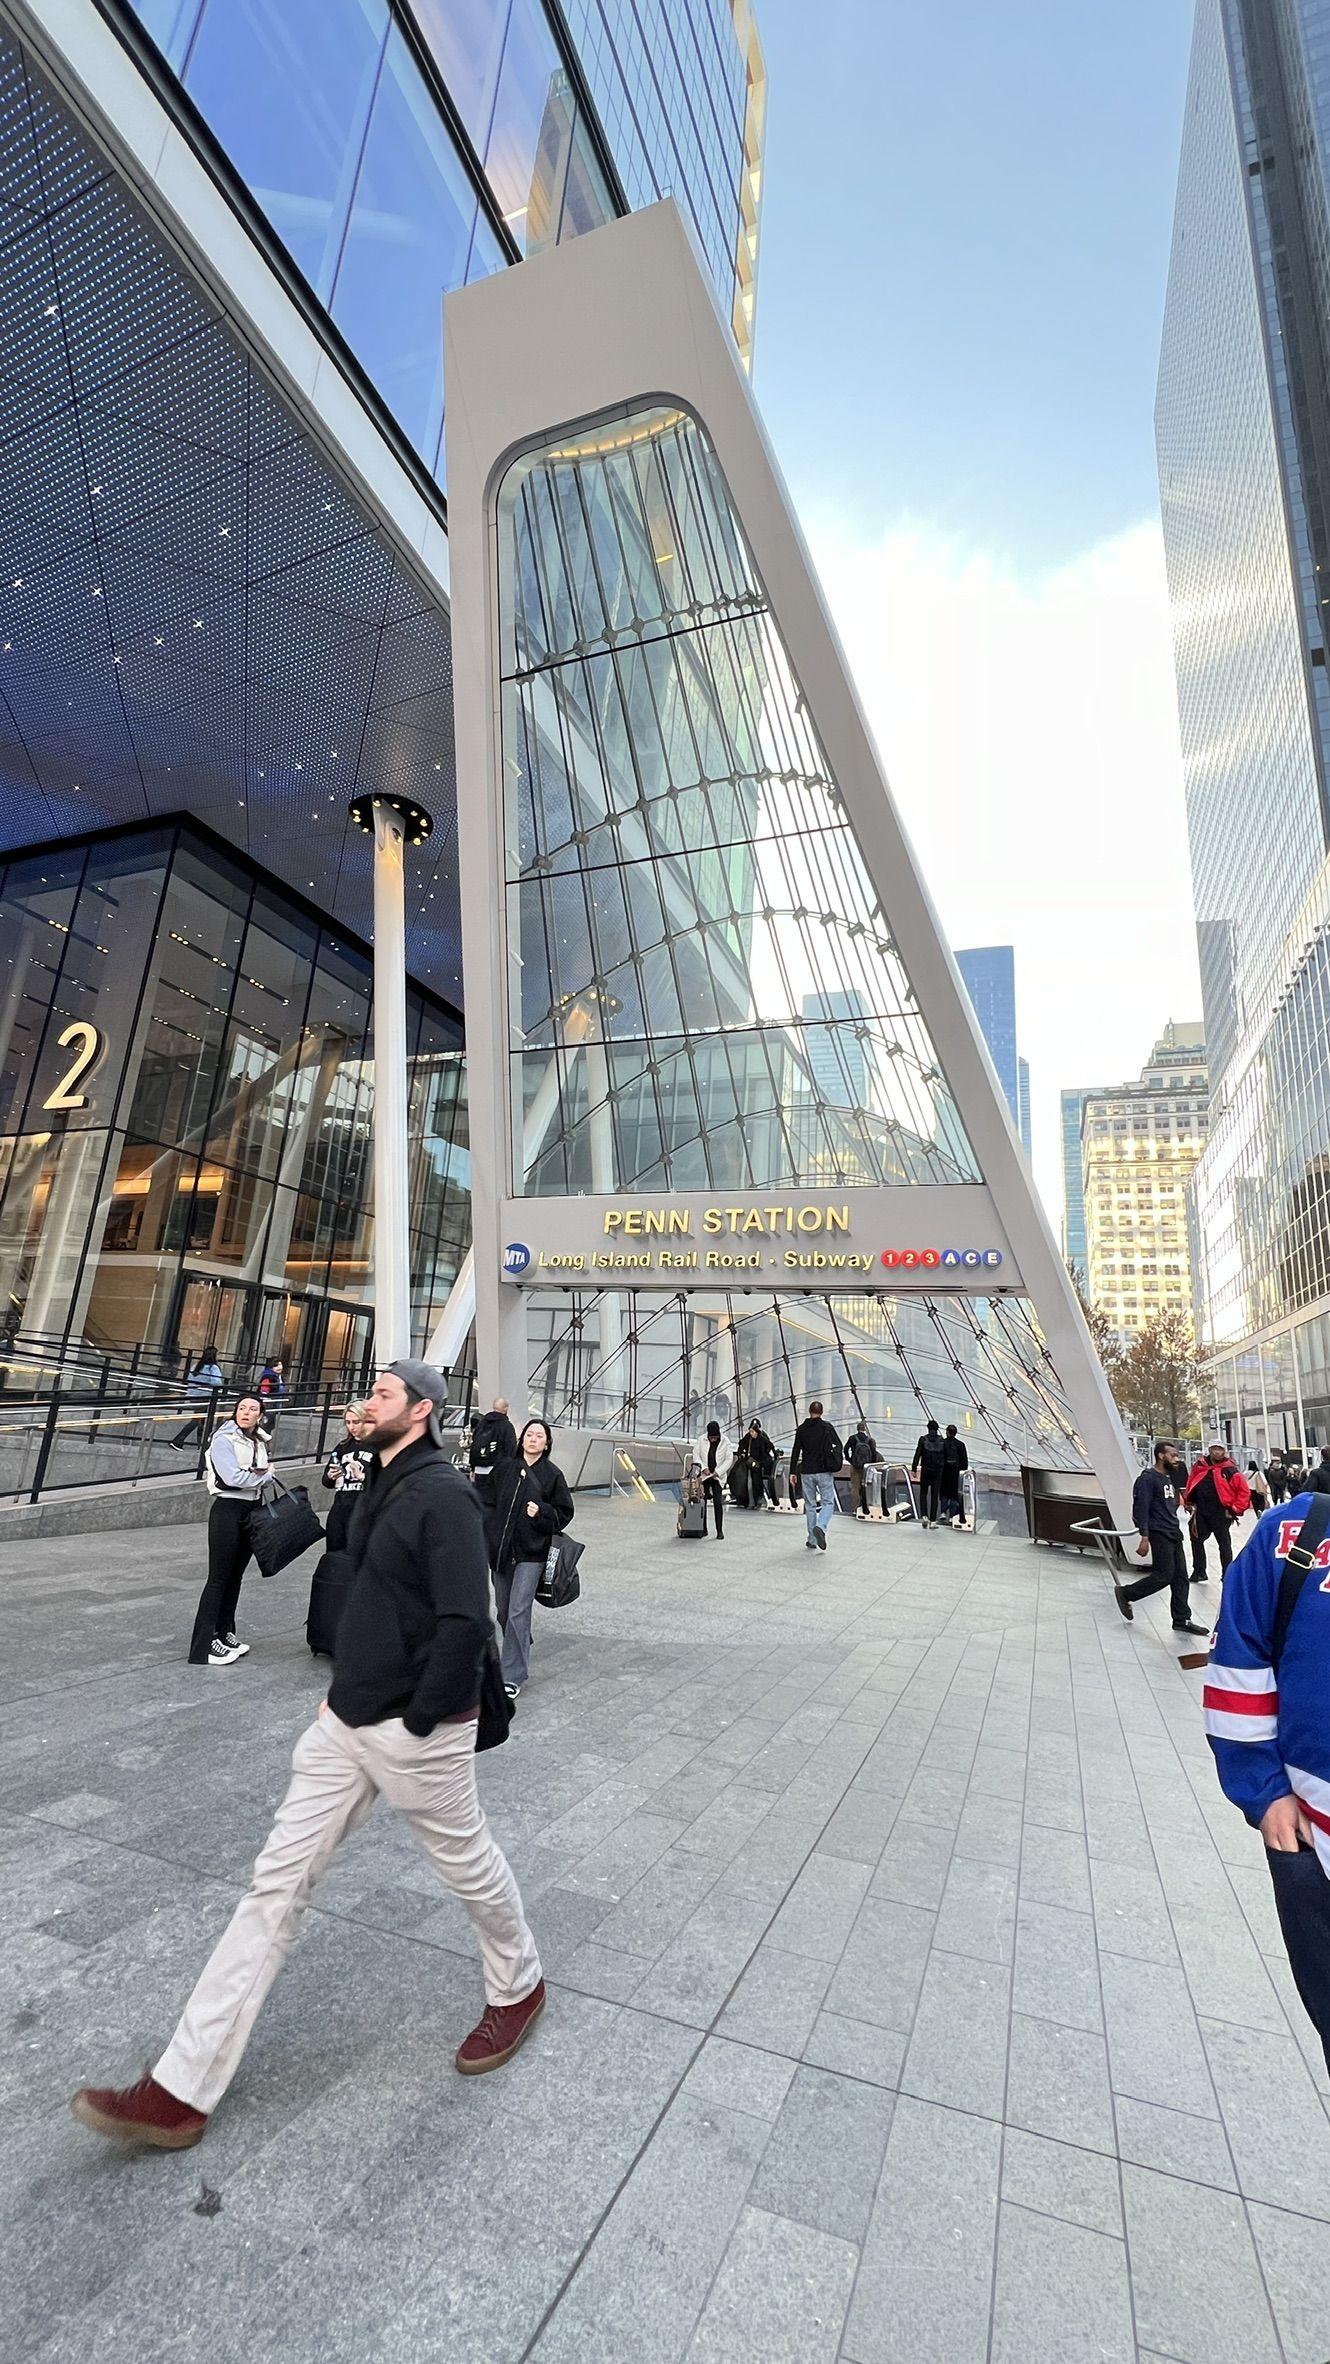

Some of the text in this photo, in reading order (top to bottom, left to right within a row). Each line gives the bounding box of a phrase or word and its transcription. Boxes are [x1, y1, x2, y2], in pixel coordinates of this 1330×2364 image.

[41, 1021, 98, 1110] 2
[603, 1206, 850, 1235] PENN STATION
[503, 1249, 526, 1268] MTA
[538, 1251, 585, 1270] Long
[591, 1251, 652, 1268] Island
[658, 1251, 698, 1268] Rail
[706, 1251, 761, 1268] Road
[783, 1250, 874, 1271] Subway
